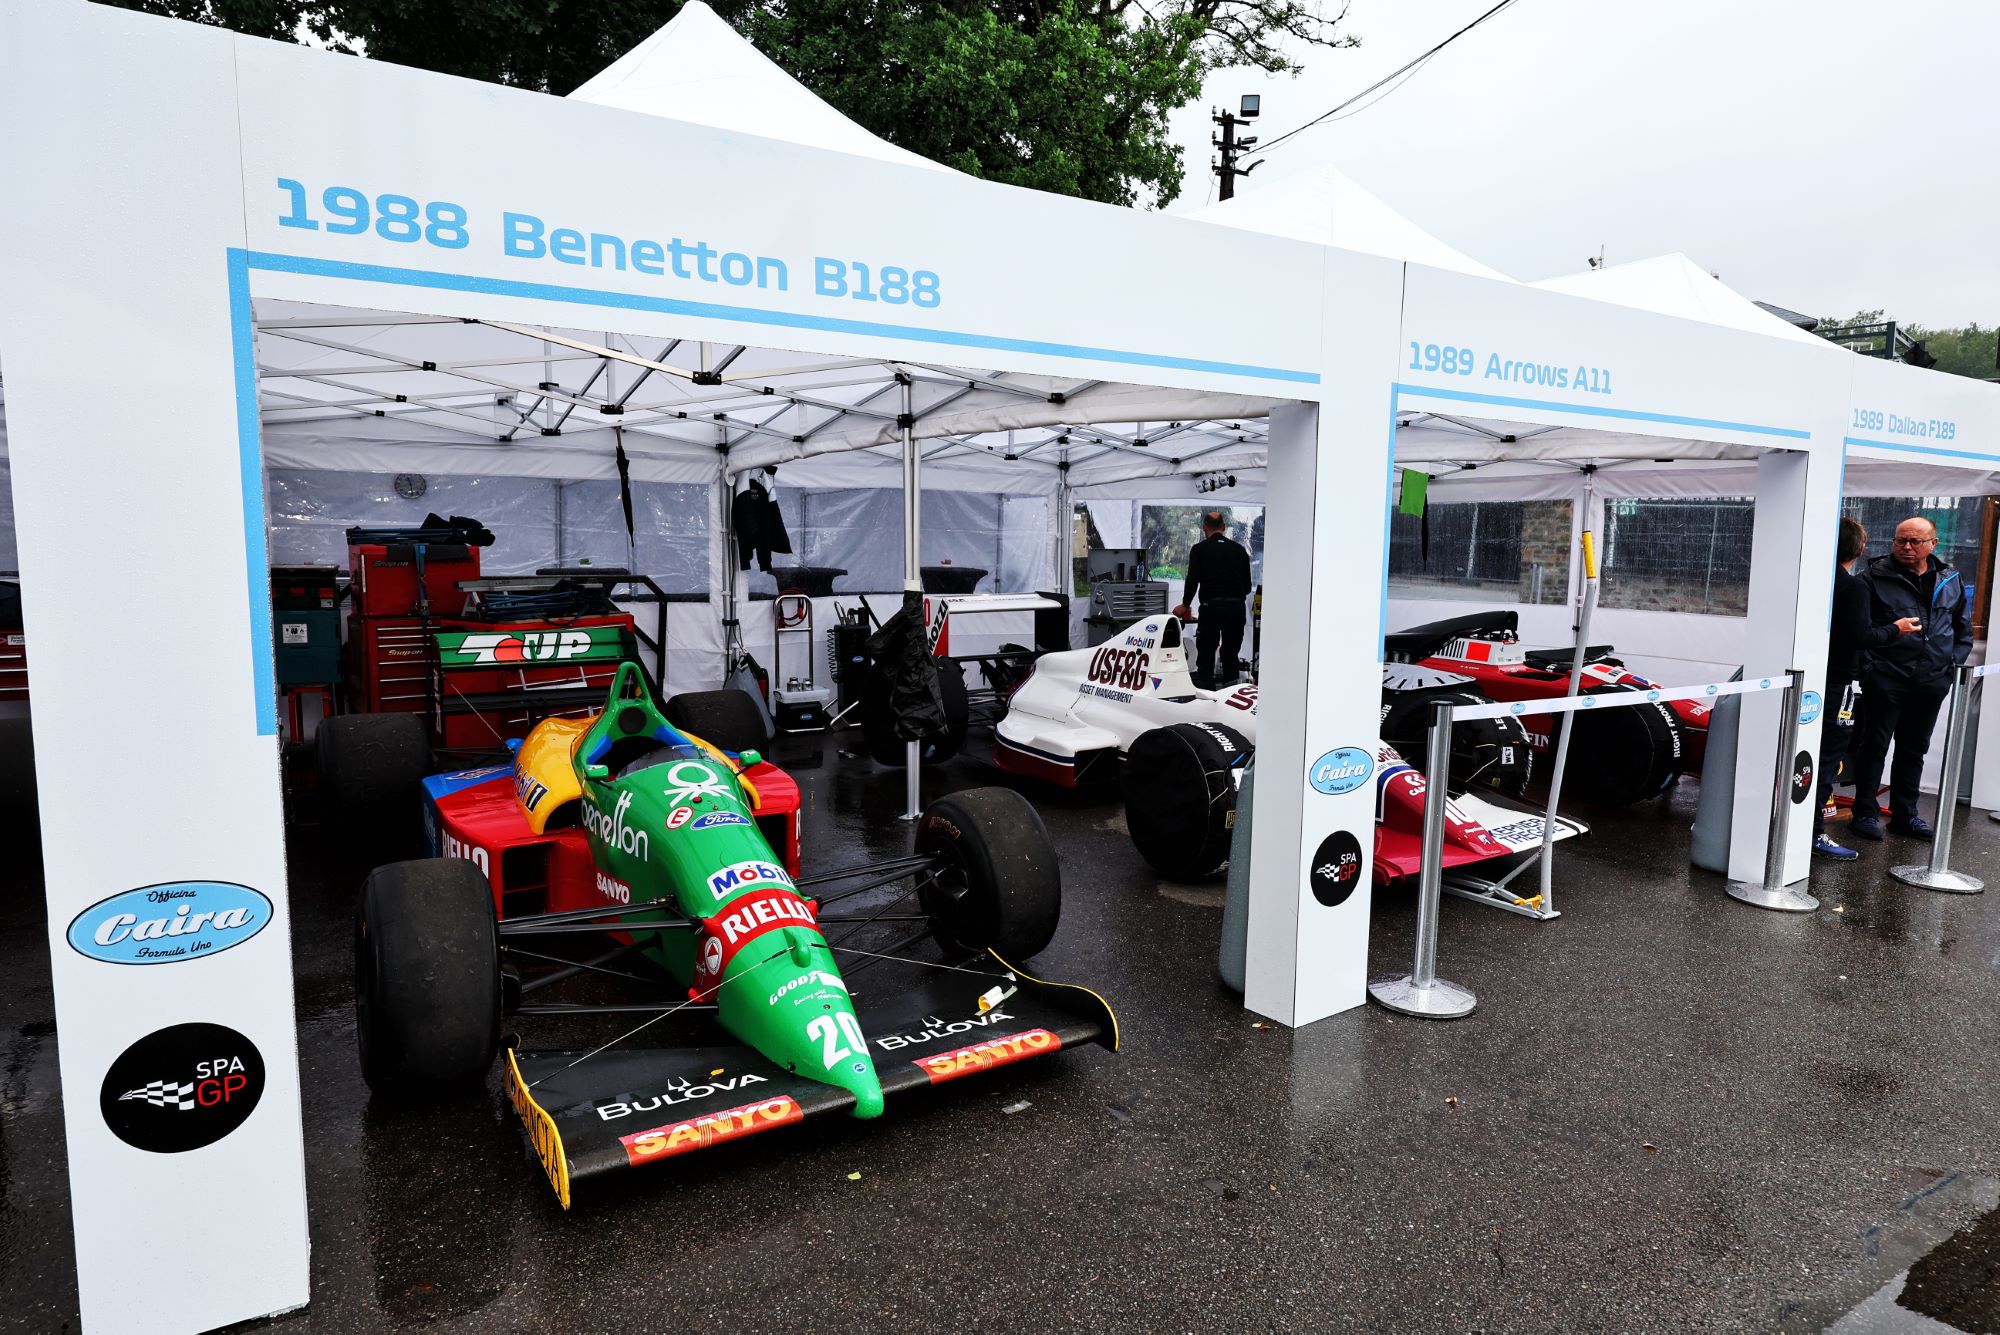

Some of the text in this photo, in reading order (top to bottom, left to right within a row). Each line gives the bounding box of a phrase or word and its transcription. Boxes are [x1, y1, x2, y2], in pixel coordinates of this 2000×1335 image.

[276, 177, 941, 308] 1988 Benetton B188
[1409, 341, 1612, 394] 1989 Arrows A11
[1853, 408, 1955, 440] 1989 Dallara F189
[388, 649, 423, 657] Snap-on
[1126, 636, 1147, 648] Mobil
[1088, 647, 1149, 691] USF&G
[1095, 686, 1133, 704] MANAGEMENT
[1206, 729, 1237, 752] RIGHT
[1504, 747, 1512, 764] WET
[1671, 729, 1681, 758] RIGHT
[1317, 760, 1368, 783] Caira
[526, 782, 550, 814] 1
[581, 790, 649, 862] benetton
[705, 813, 740, 825] Ford
[1339, 863, 1357, 881] GP
[1340, 852, 1357, 865] SPA
[597, 872, 630, 904] SANYO
[712, 864, 791, 894] Mobil
[146, 889, 197, 904] Officina
[94, 903, 255, 947] Caira
[721, 898, 816, 945] RIELLO
[135, 940, 212, 958] Formula Uno
[806, 1010, 870, 1072] 20
[875, 1012, 1016, 1051] BULOVA
[196, 1056, 246, 1079] SPA
[927, 1031, 1051, 1075] SANYO
[197, 1073, 247, 1107] GP
[596, 1073, 769, 1121] BULOVA
[633, 1099, 793, 1155] SANYO
